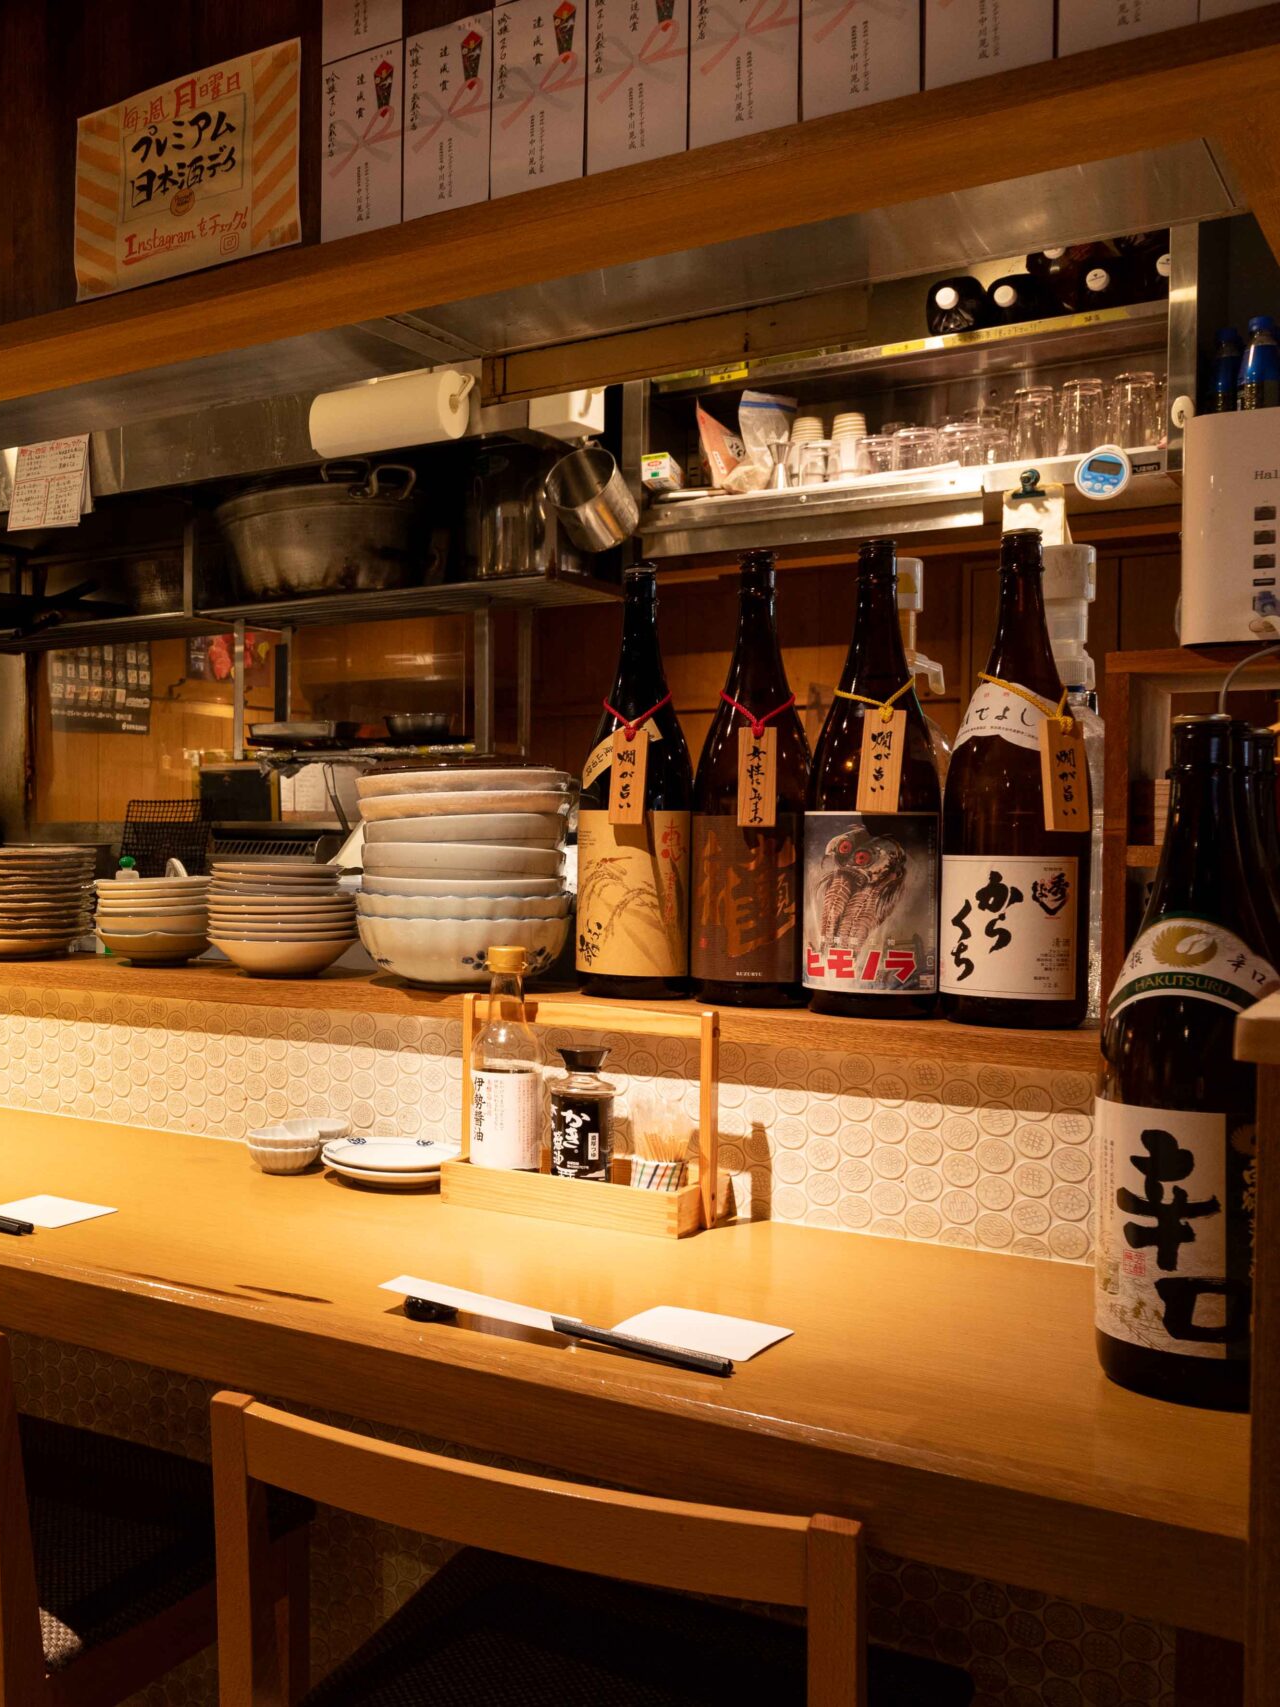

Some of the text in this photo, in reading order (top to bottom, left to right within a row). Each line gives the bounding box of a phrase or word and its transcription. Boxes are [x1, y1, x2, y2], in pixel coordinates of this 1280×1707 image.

[131, 110, 236, 162] プレミアム
[871, 729, 894, 792] 燗が旨い
[1056, 747, 1077, 816] 燗が旨い
[806, 946, 917, 985] ヒモノラ
[1134, 973, 1233, 997] HAKUTSURU
[1116, 1129, 1256, 1344] 辛口
